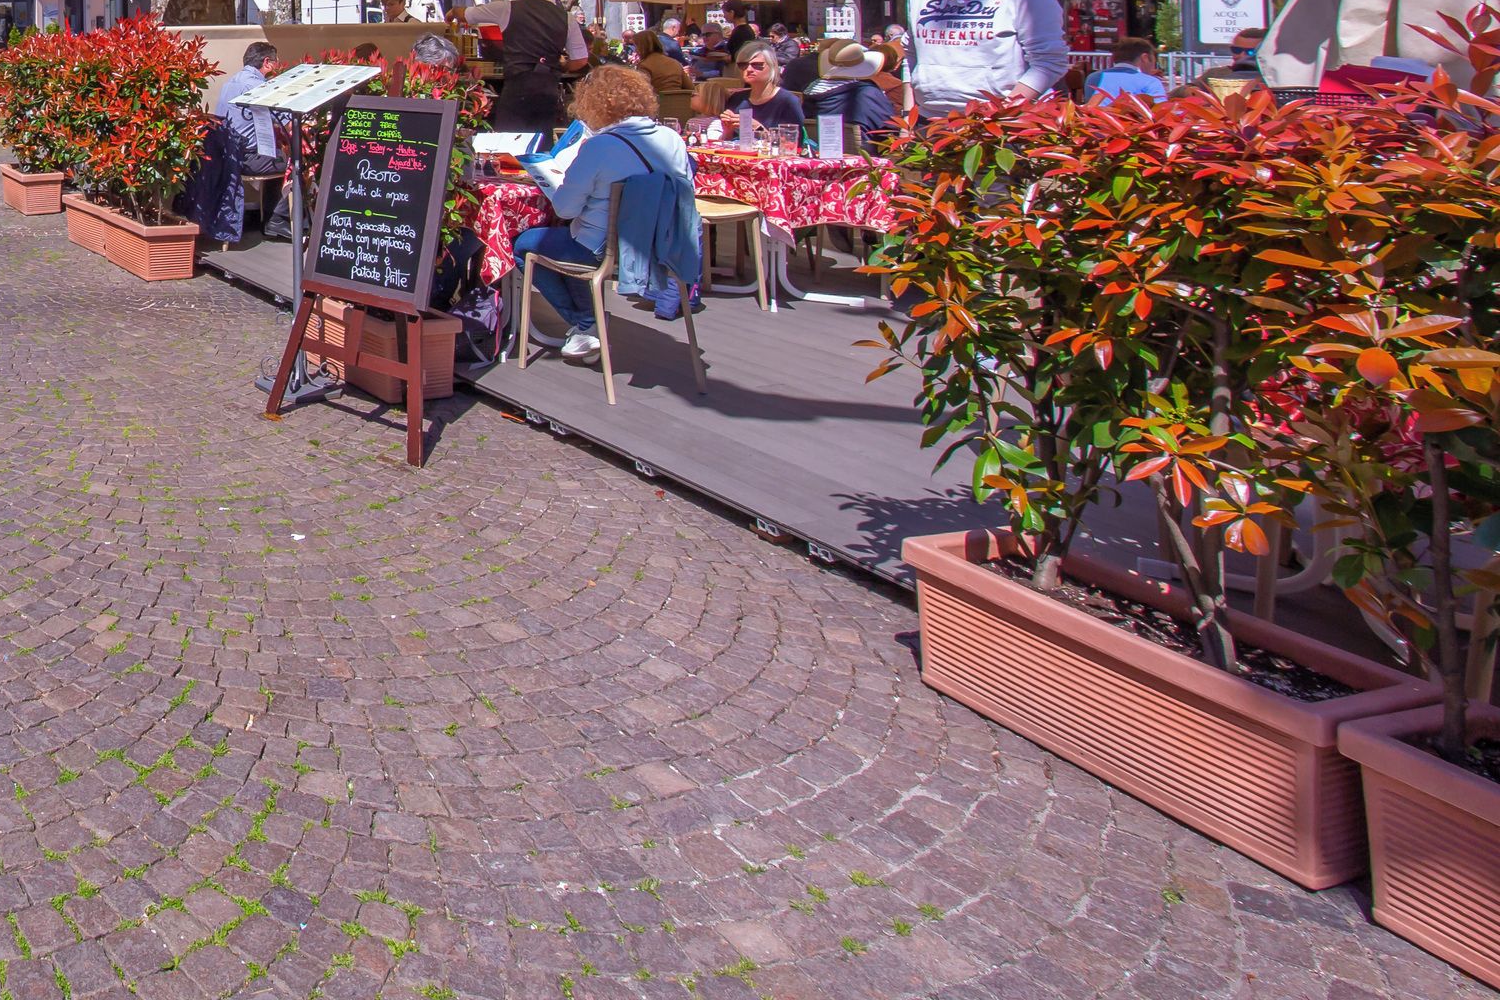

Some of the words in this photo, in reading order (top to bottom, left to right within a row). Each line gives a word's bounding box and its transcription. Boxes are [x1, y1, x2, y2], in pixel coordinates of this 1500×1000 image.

[1213, 11, 1249, 19] ACQUA
[345, 180, 367, 199] frutti
[371, 187, 382, 198] di
[386, 192, 409, 207] mare
[325, 228, 353, 247] griglia
[355, 234, 370, 250] con
[320, 245, 355, 260] pomodoro
[384, 256, 391, 266] e
[351, 265, 381, 280] patate
[384, 266, 411, 288] fritte
